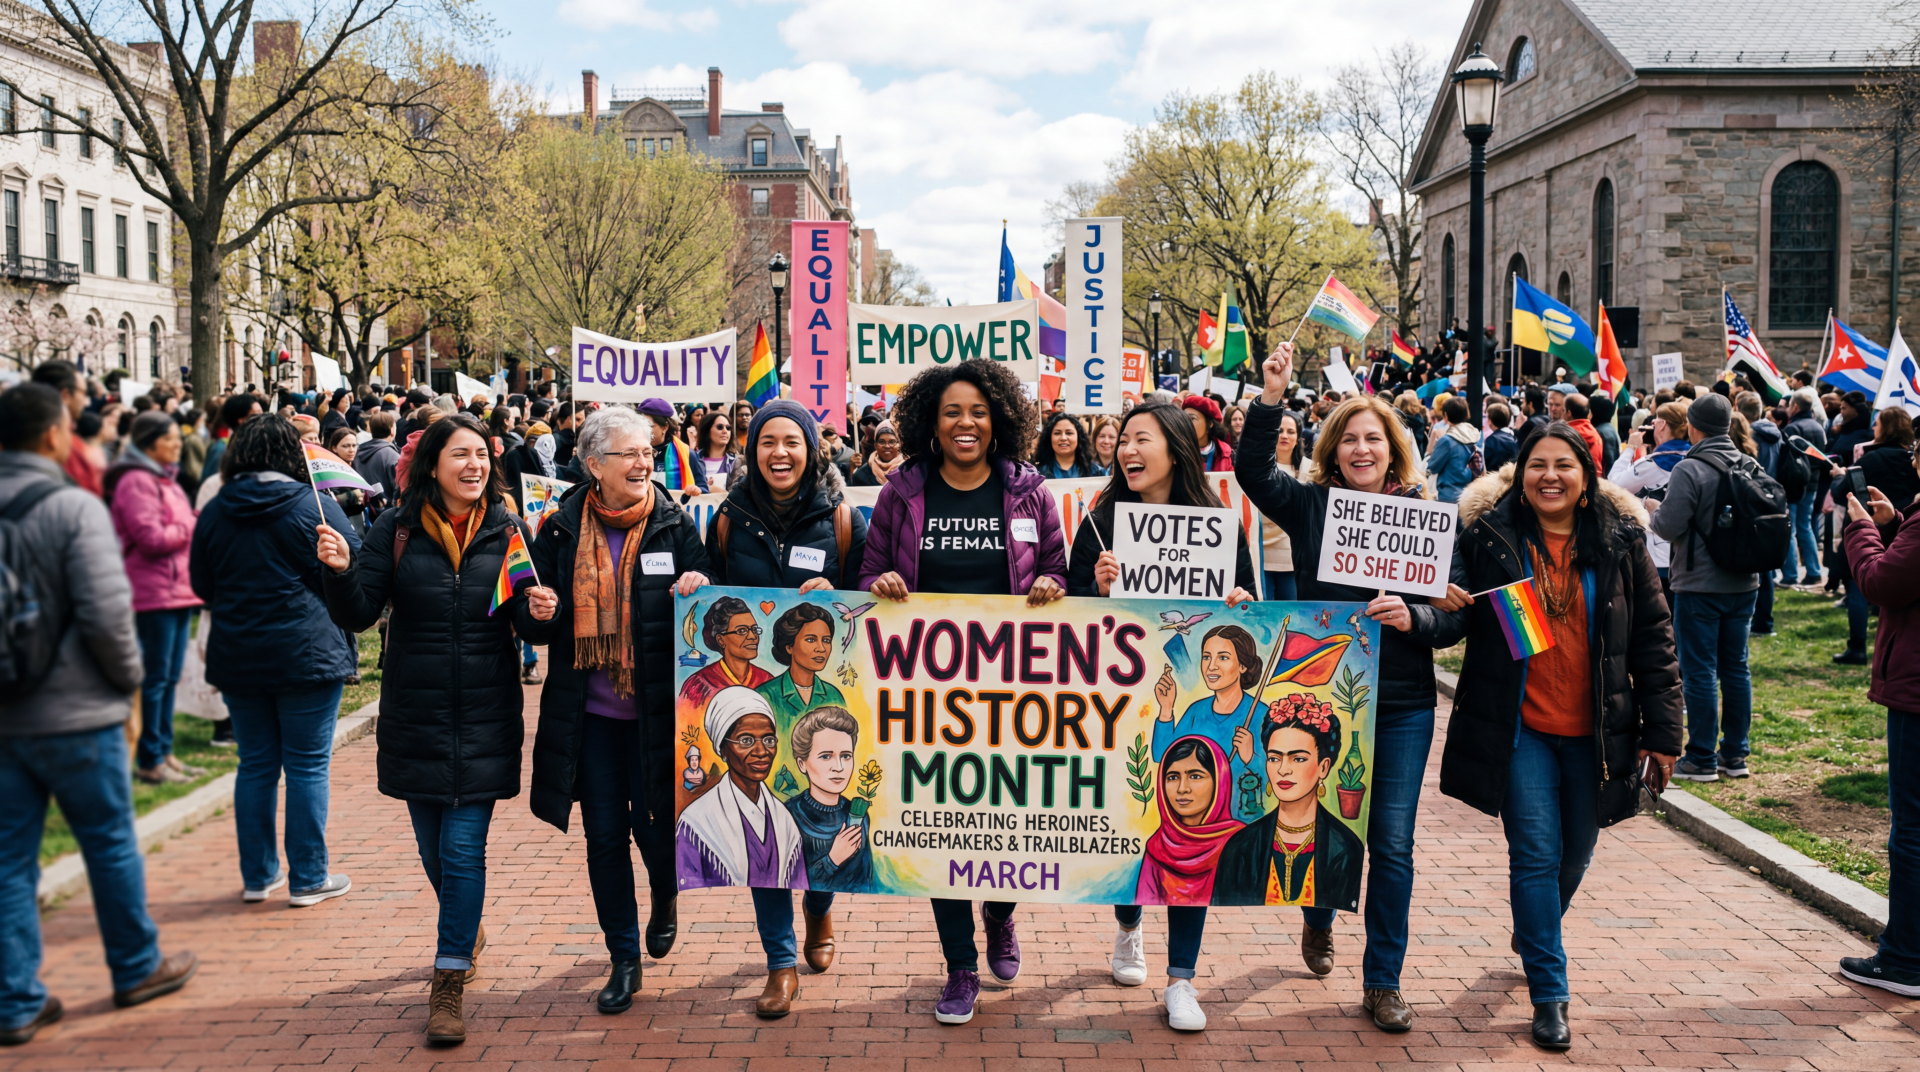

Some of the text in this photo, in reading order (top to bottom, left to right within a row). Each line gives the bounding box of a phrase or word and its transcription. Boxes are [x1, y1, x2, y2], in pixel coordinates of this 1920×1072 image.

[1083, 225, 1105, 407] JUSTICE
[857, 319, 1033, 364] EMPOWER
[578, 343, 731, 387] EQUALITY
[928, 518, 1000, 531] FUTURE
[1128, 512, 1222, 548] VOTES
[1332, 498, 1451, 533] SHE BELIEVED
[794, 551, 818, 562] MAYA
[920, 537, 1007, 550] IS FEMAL
[1158, 548, 1190, 562] FOR
[1336, 525, 1438, 561] SHE COULD,
[1121, 563, 1225, 598] WOMEN
[1333, 551, 1436, 585] SO SHE DID
[865, 615, 1146, 687] WOMEN'S
[877, 687, 1132, 751] HISTORY
[901, 750, 1106, 809] MONTH
[901, 810, 1117, 835] CELEBRATING HEROINES,
[873, 830, 1141, 855] CHANGEMAKERS & TRAILBLAZERS
[949, 859, 1060, 891] MARCH
